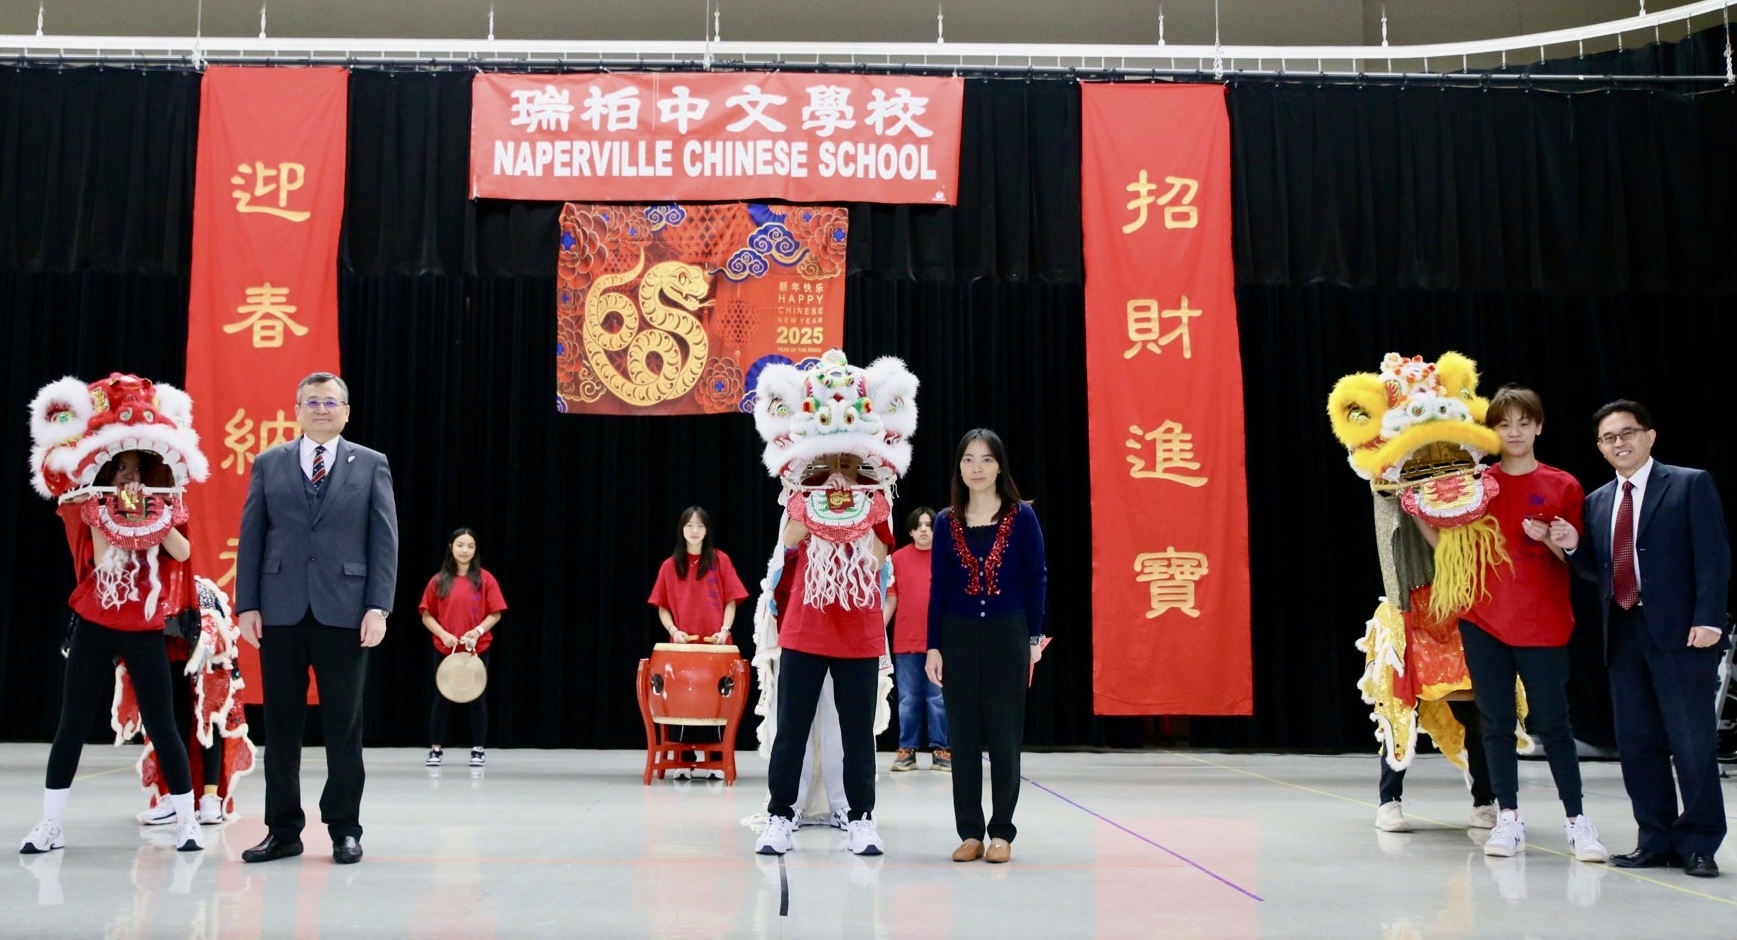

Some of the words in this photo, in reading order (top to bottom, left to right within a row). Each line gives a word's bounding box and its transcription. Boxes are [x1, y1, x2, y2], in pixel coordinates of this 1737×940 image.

[511, 84, 934, 138] 瑞柏中文學校
[493, 139, 673, 177] NAPERVILLE
[683, 139, 808, 178] CHINESE
[818, 140, 937, 180] SCHOOL
[778, 294, 824, 304] HAPPY
[778, 306, 824, 315] CHINESE
[775, 326, 824, 345] 2025
[800, 317, 823, 325] YEAR
[216, 161, 310, 600] 迎春納
[1122, 168, 1209, 620] 招財進寶
